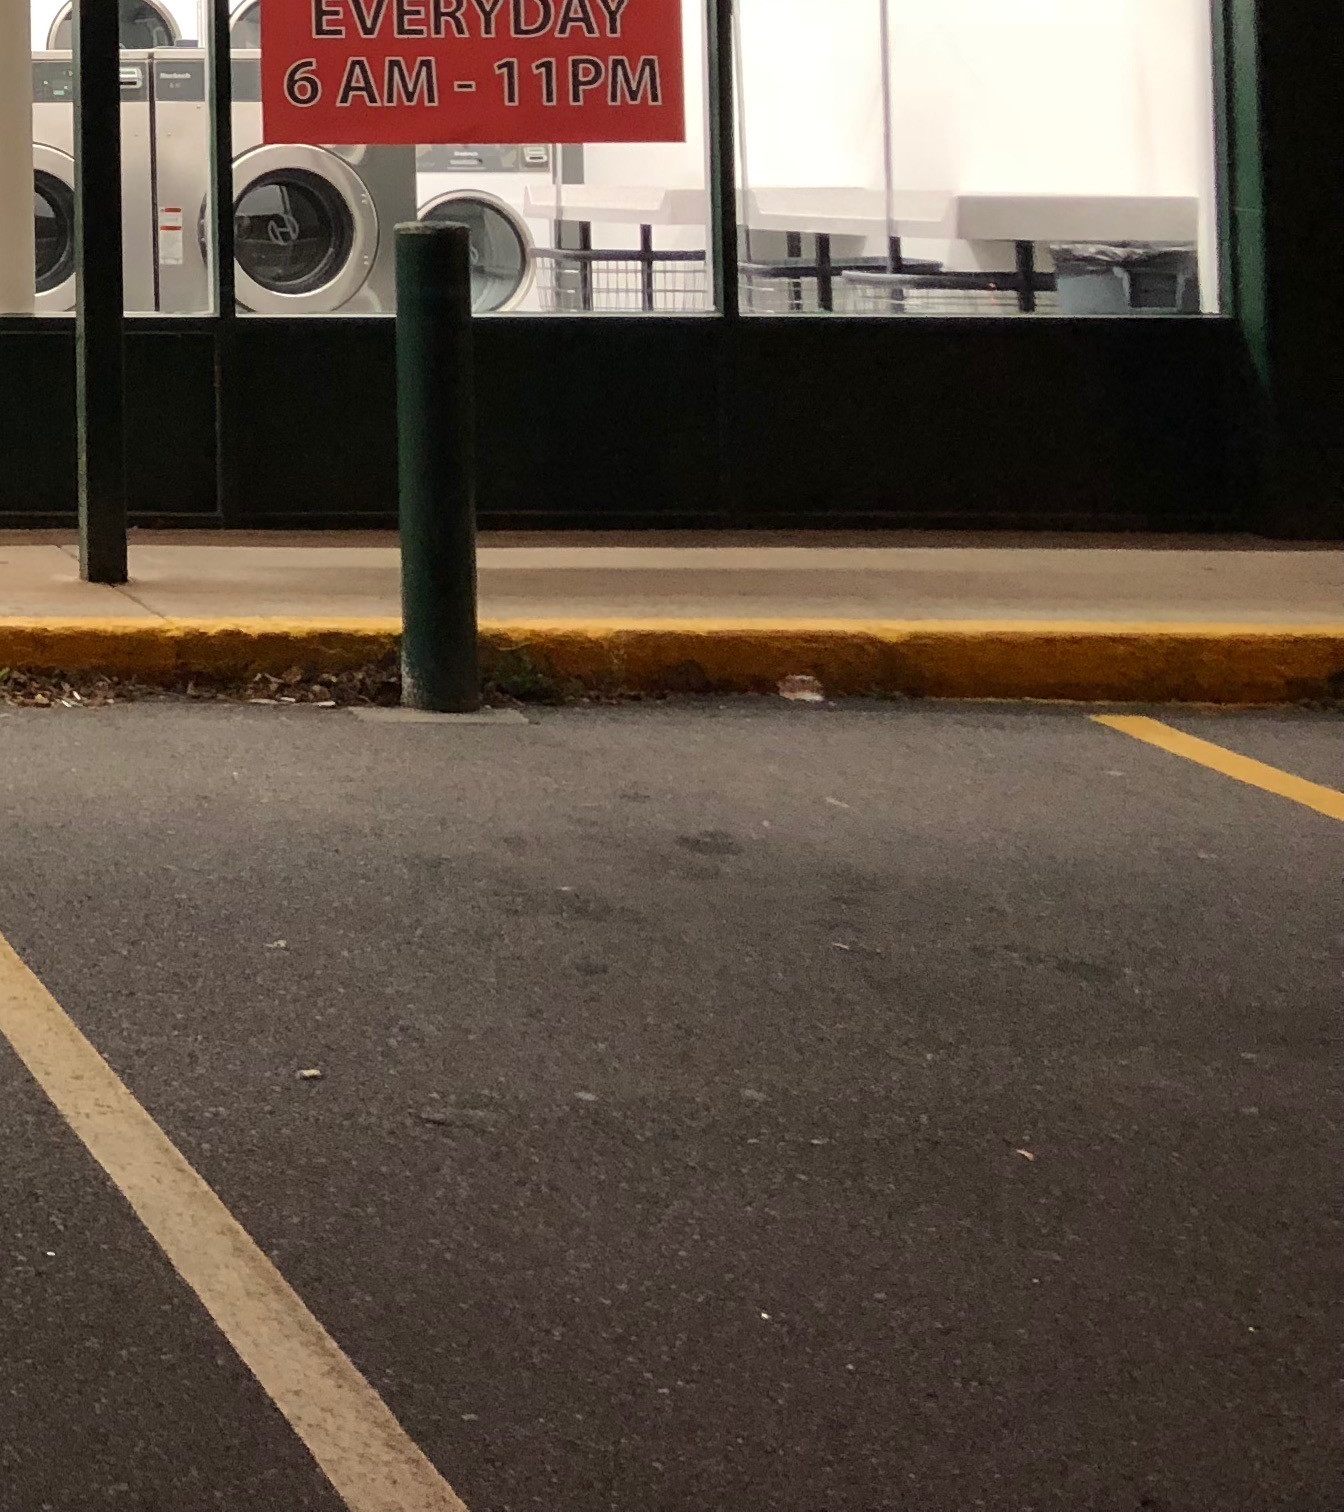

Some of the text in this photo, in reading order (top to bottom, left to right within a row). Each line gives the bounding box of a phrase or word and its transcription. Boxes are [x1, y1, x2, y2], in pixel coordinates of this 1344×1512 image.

[284, 55, 663, 107] 6 AM - 11PM
